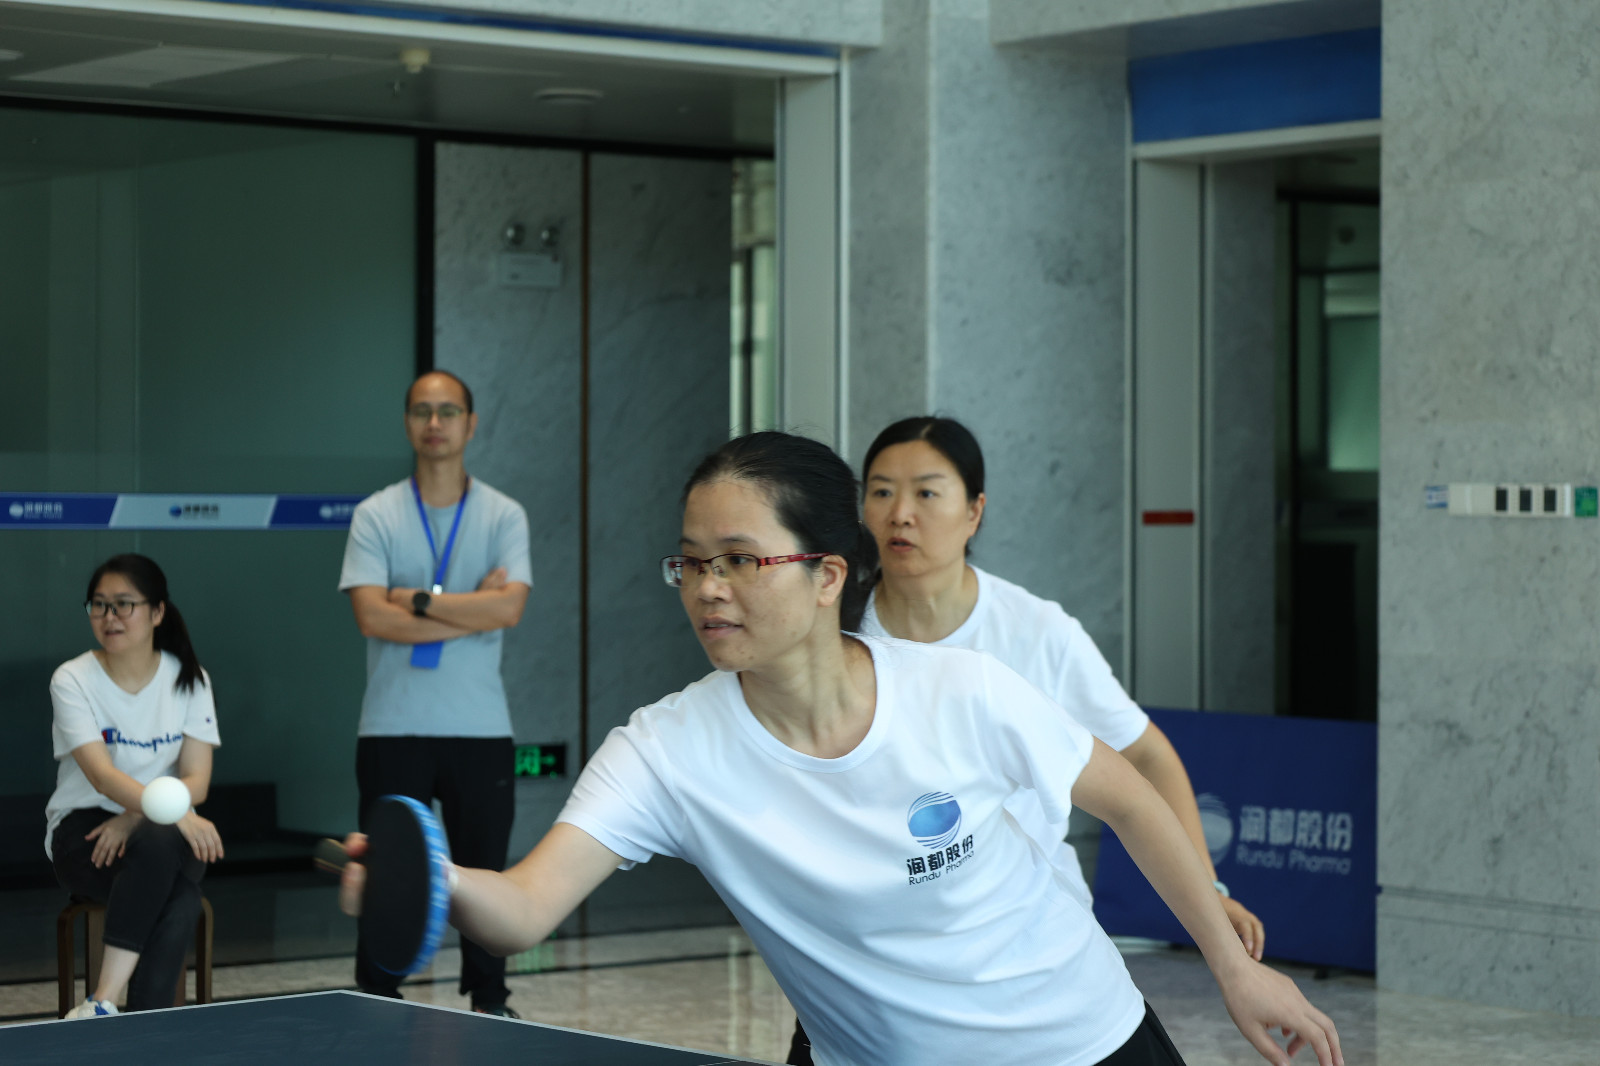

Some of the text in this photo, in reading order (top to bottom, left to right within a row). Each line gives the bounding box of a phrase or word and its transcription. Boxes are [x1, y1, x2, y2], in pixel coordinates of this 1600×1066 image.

[906, 834, 973, 875] 润都股份
[908, 850, 974, 886] Rundu Pharma
